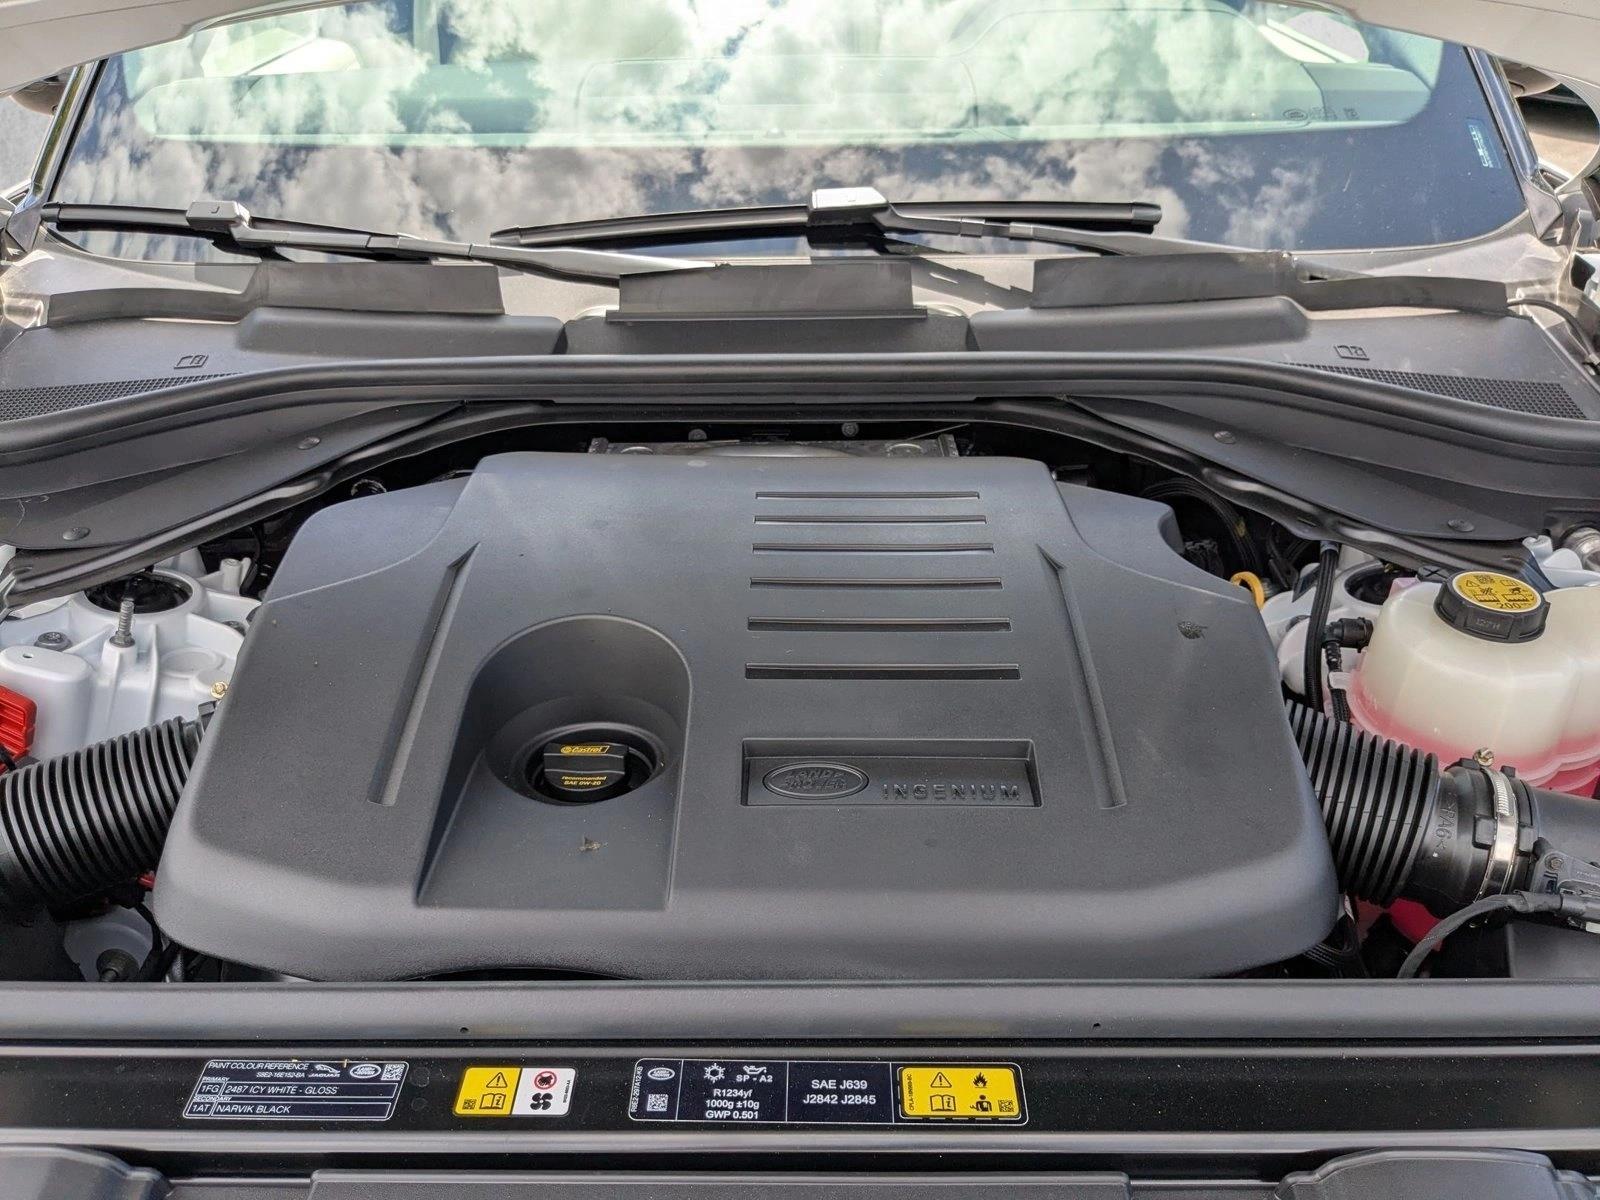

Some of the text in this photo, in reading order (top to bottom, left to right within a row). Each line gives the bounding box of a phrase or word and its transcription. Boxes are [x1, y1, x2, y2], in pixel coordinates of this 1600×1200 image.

[571, 745, 602, 754] Castrol
[881, 783, 1020, 800] INGENIUM
[208, 1062, 309, 1071] PAINT COLOUR REFERENCE
[736, 1074, 750, 1083] SP
[759, 1074, 773, 1083] A2
[201, 1084, 220, 1093] 1FG
[811, 1079, 868, 1090] SAE J639
[225, 1085, 248, 1094] 2487
[249, 1086, 266, 1094] ICY
[267, 1086, 297, 1094] WHITE
[305, 1086, 339, 1095] GLOSS
[713, 1089, 753, 1098] R1234yf
[803, 1094, 877, 1105] J2842 J2845
[192, 1104, 211, 1113] 1AT
[216, 1104, 291, 1114] NARVIK BLACK
[705, 1100, 760, 1110] 1000g ±10g
[705, 1110, 759, 1120] GWP 0.501
